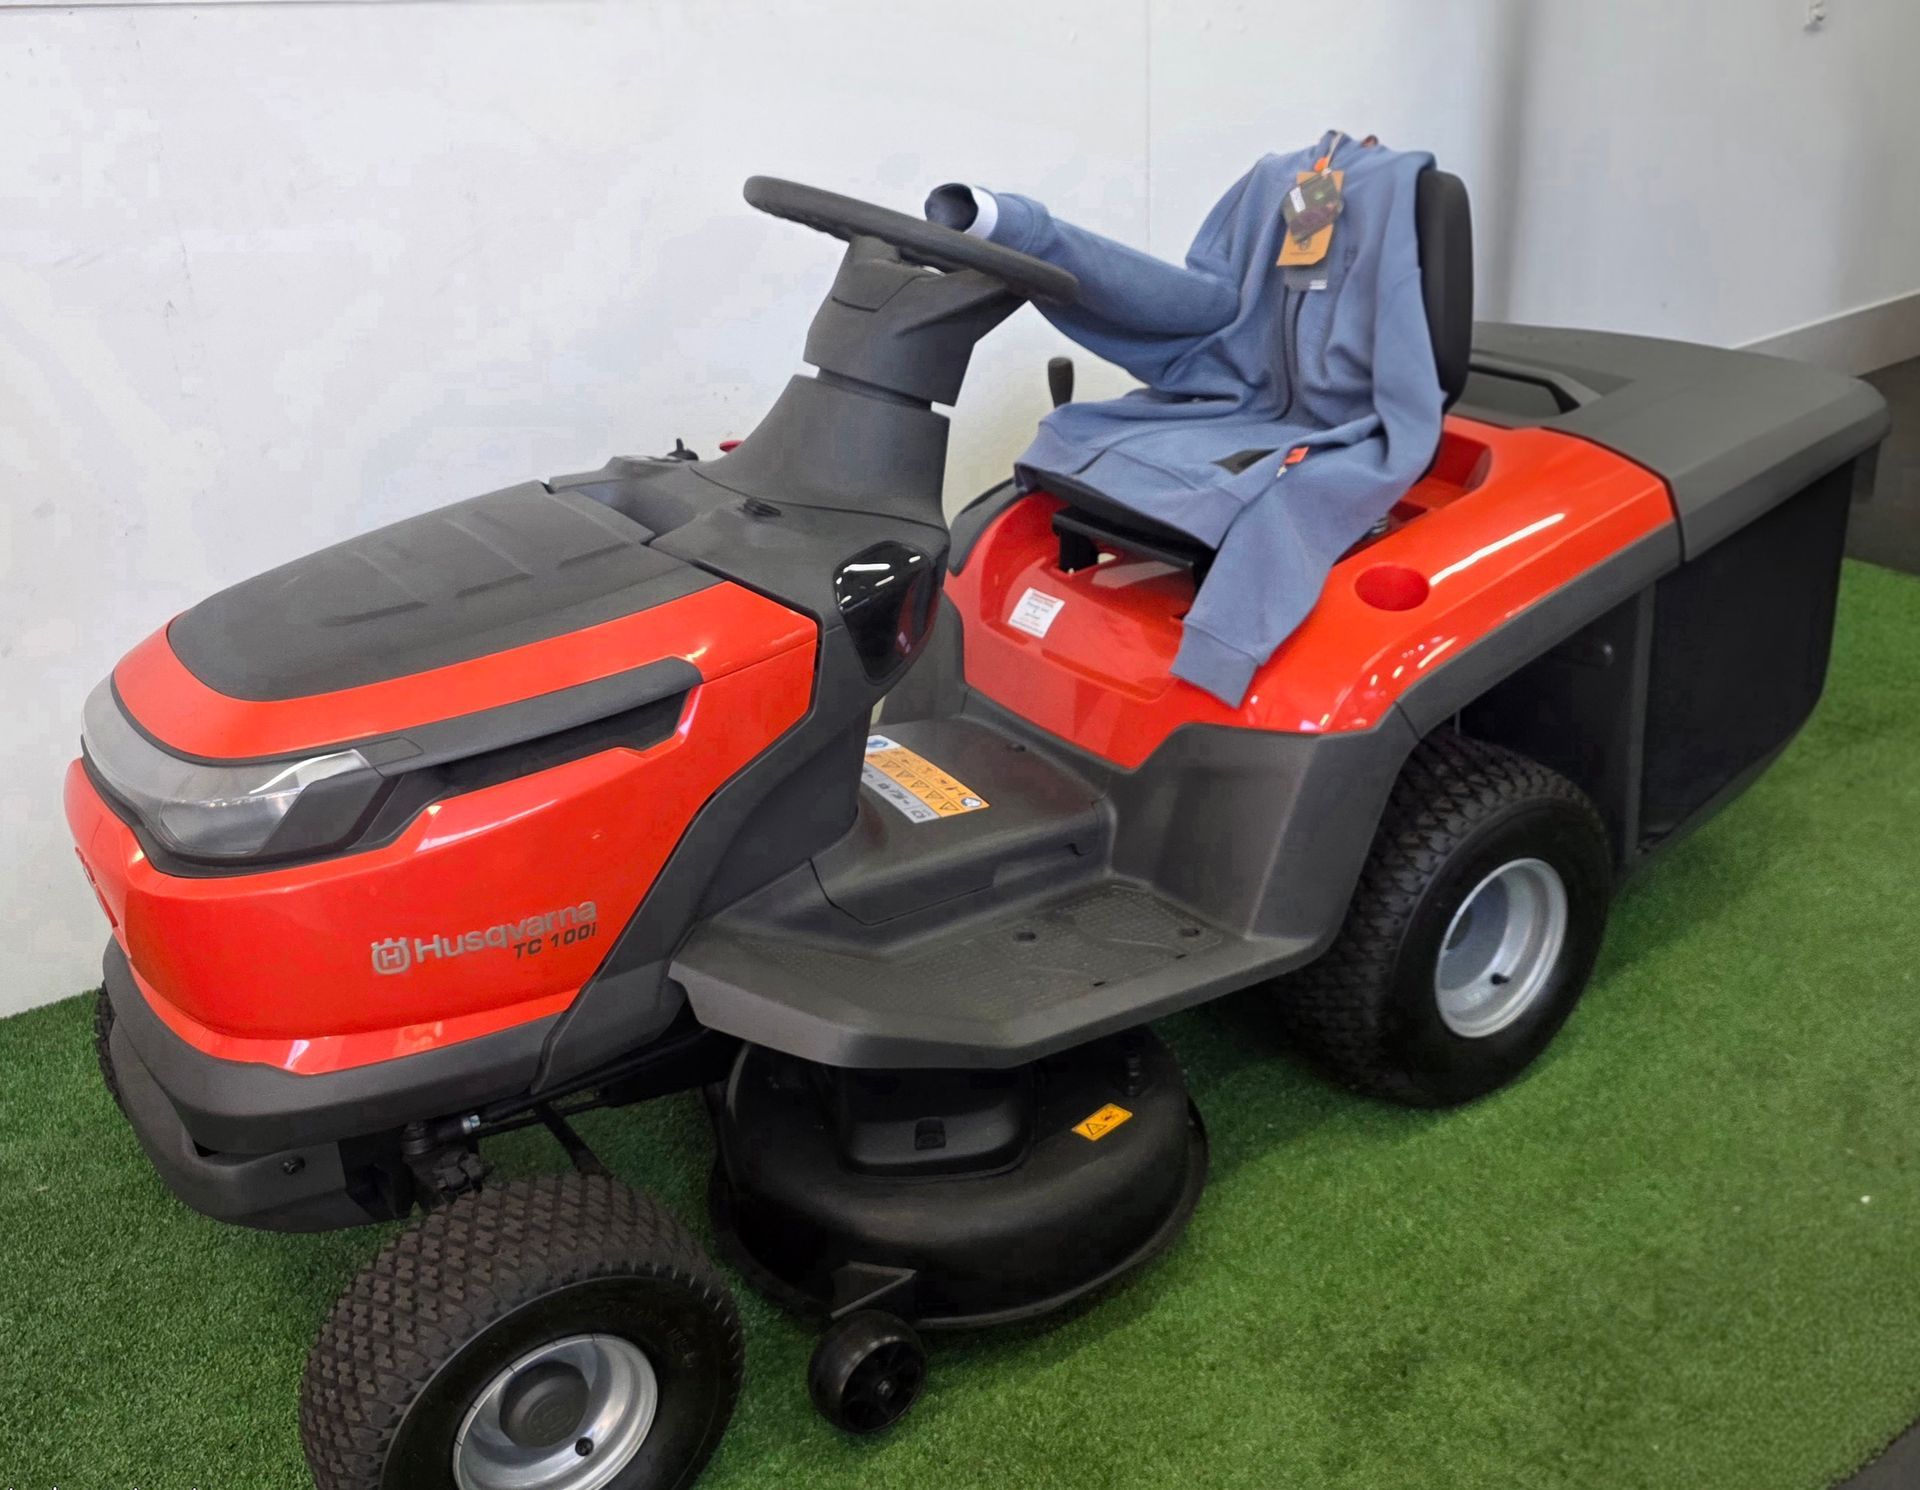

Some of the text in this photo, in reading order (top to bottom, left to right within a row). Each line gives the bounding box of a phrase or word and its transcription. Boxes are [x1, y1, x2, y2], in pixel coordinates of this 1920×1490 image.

[414, 901, 597, 963] Husqvarna
[514, 922, 597, 960] TC 100i
